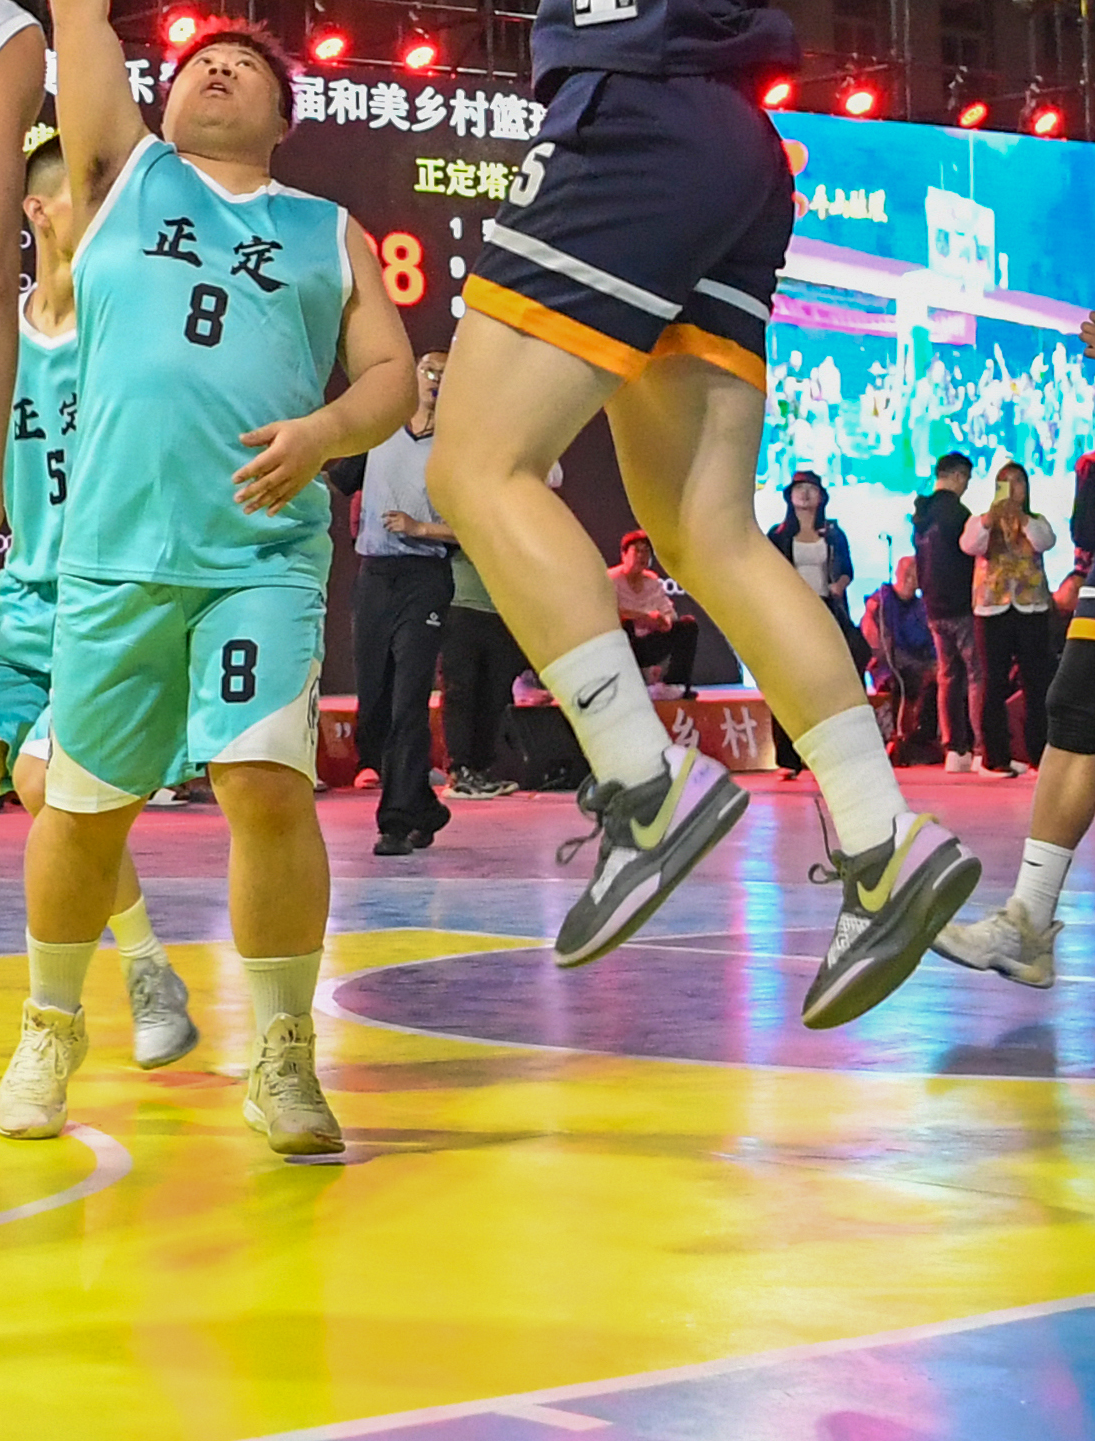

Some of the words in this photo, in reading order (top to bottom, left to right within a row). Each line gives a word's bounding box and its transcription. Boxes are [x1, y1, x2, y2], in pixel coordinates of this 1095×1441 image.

[413, 157, 519, 201] 正定塔
[142, 216, 290, 294] 正定
[363, 229, 426, 307] 8
[183, 282, 229, 348] 8
[46, 448, 68, 506] 5
[220, 638, 259, 704] 8
[671, 706, 758, 759] 乡村
